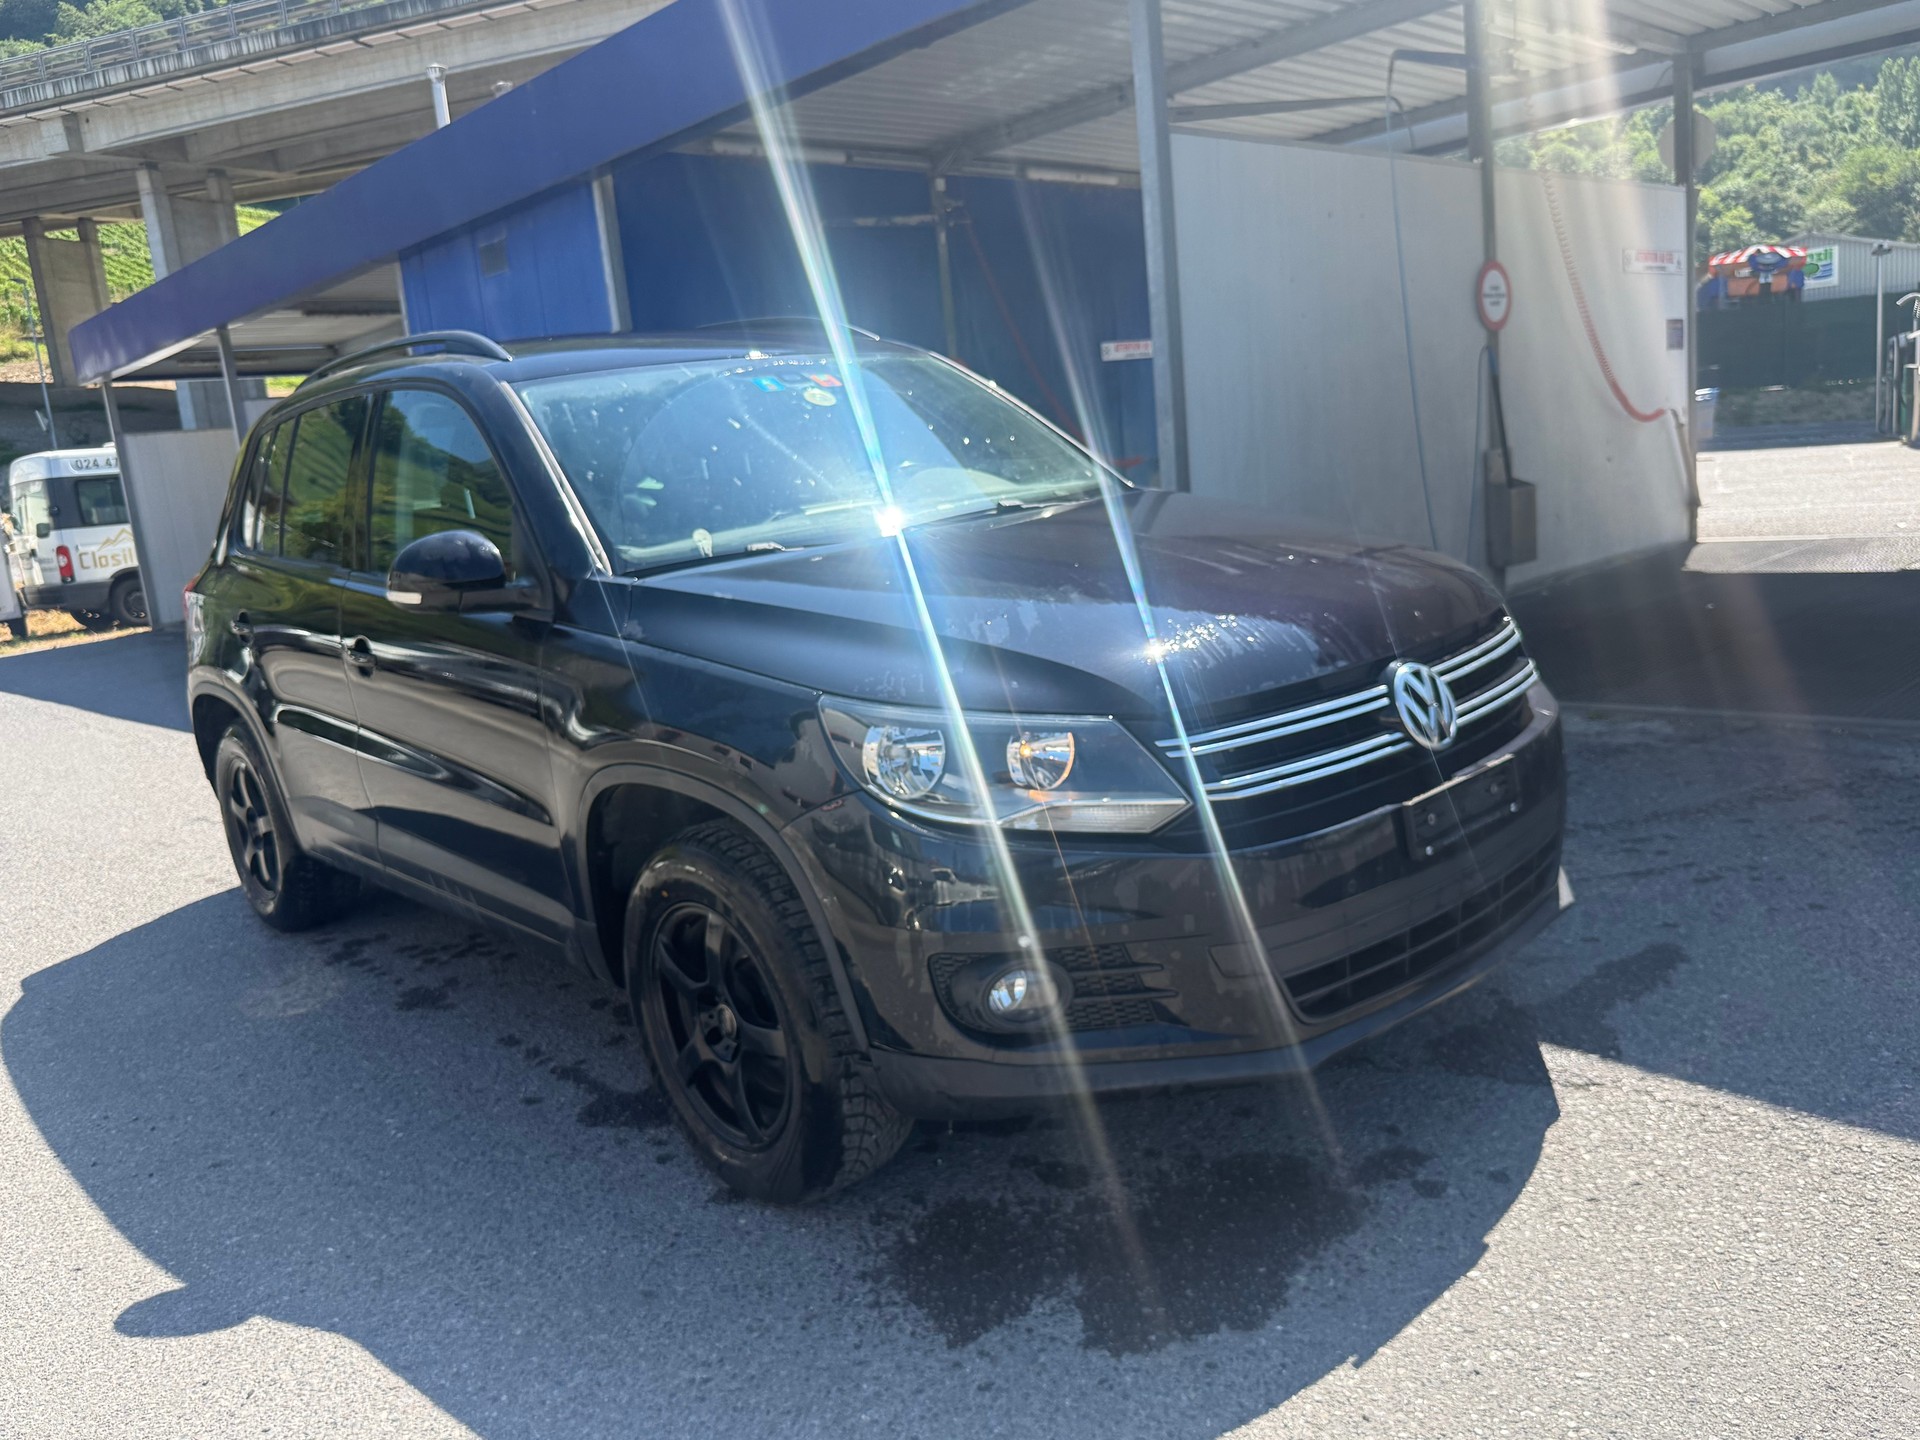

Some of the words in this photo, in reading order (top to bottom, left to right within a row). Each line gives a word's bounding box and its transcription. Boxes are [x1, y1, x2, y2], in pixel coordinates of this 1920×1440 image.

[75, 457, 99, 470] 024
[79, 548, 134, 570] Closil
[1394, 662, 1457, 750] VW
